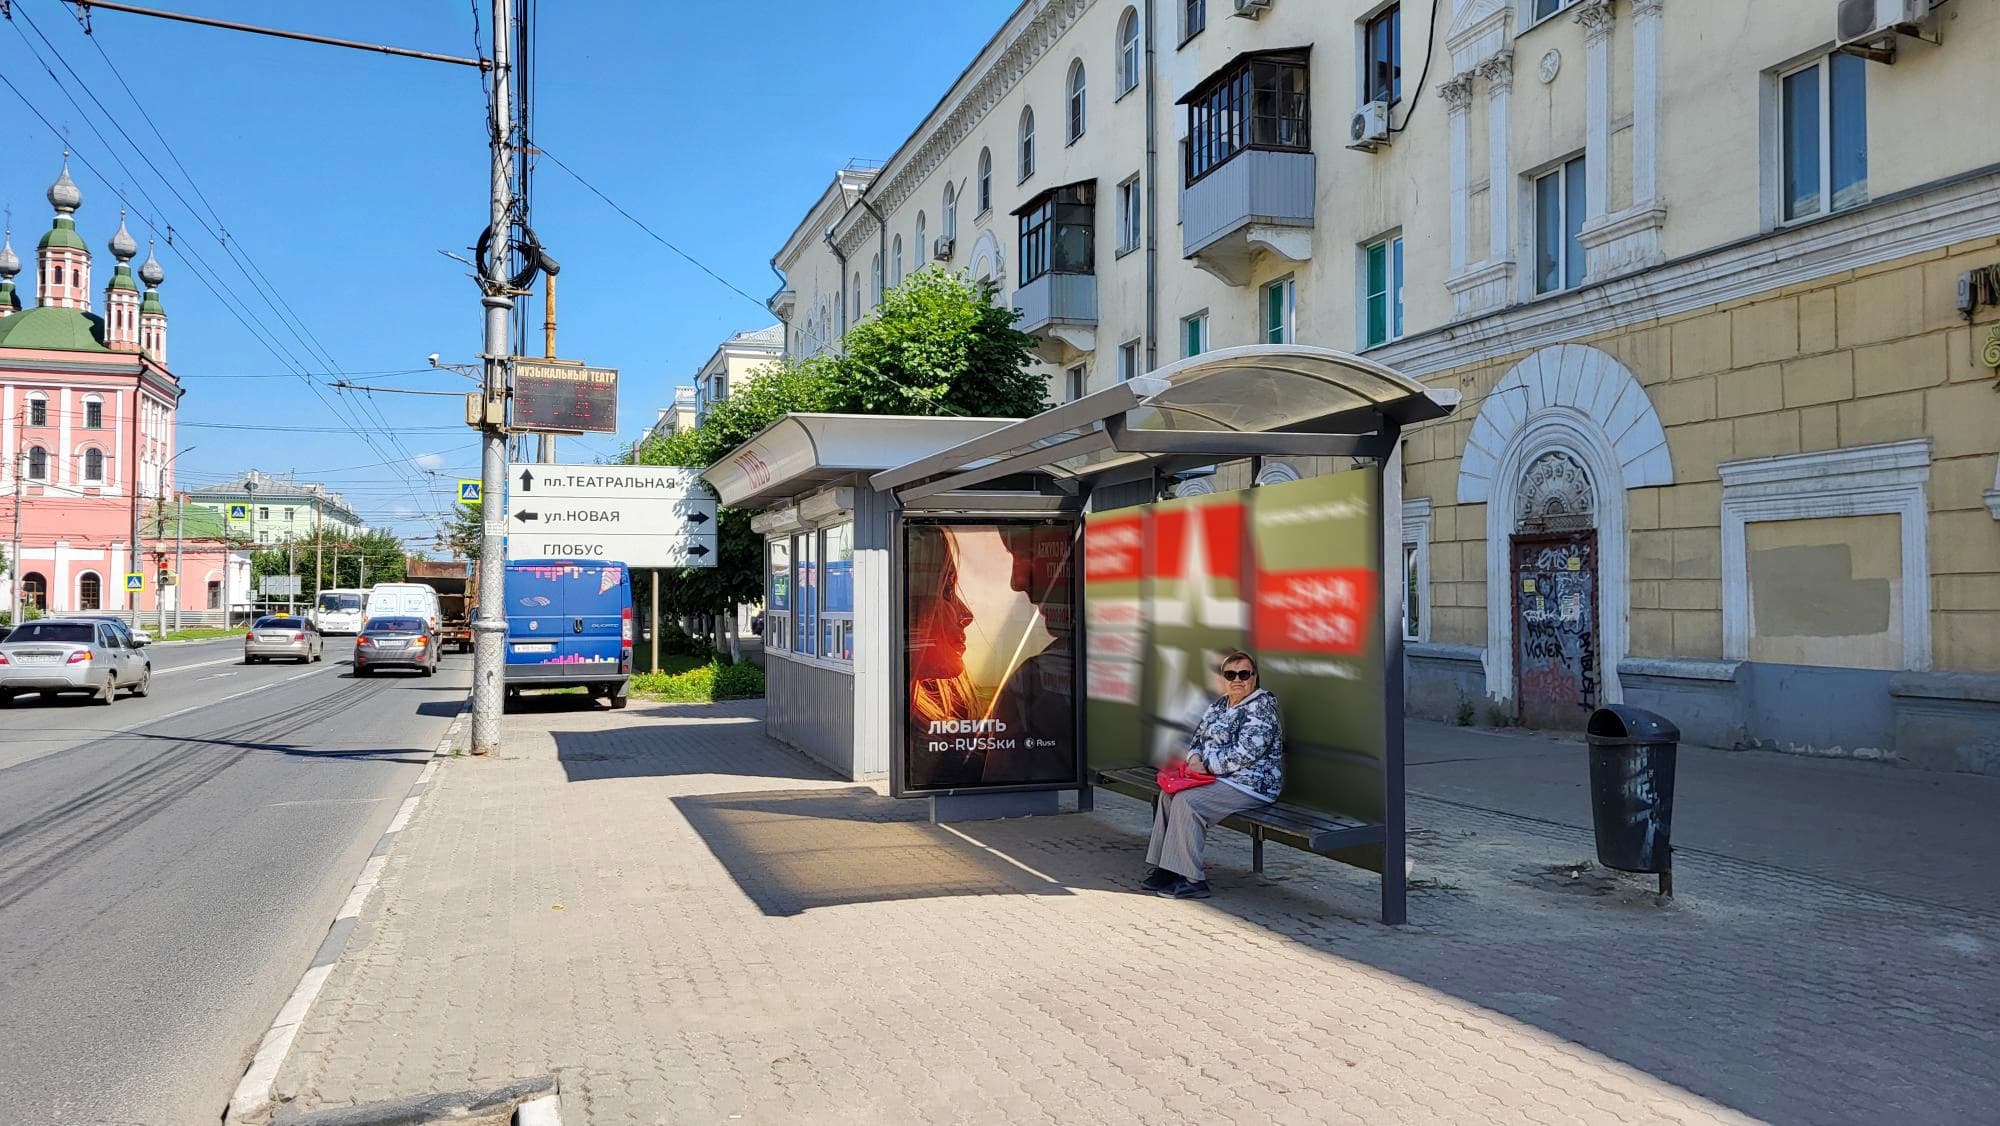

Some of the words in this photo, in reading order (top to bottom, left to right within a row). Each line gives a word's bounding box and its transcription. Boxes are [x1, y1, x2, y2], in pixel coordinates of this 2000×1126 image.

[516, 366, 588, 381] МУЗЫКАЛЬНЫЙ
[590, 371, 616, 384] ТЕАТР
[543, 476, 676, 489] пл.ТЕАТРАЛЬНАЯ
[543, 510, 621, 524] ул.НОВАЯ
[543, 544, 604, 556] ГЛОБУС
[928, 719, 1007, 735] ЛЮБИТЬ
[928, 737, 1016, 752] по-RUSSки
[1036, 739, 1056, 747] Russ
